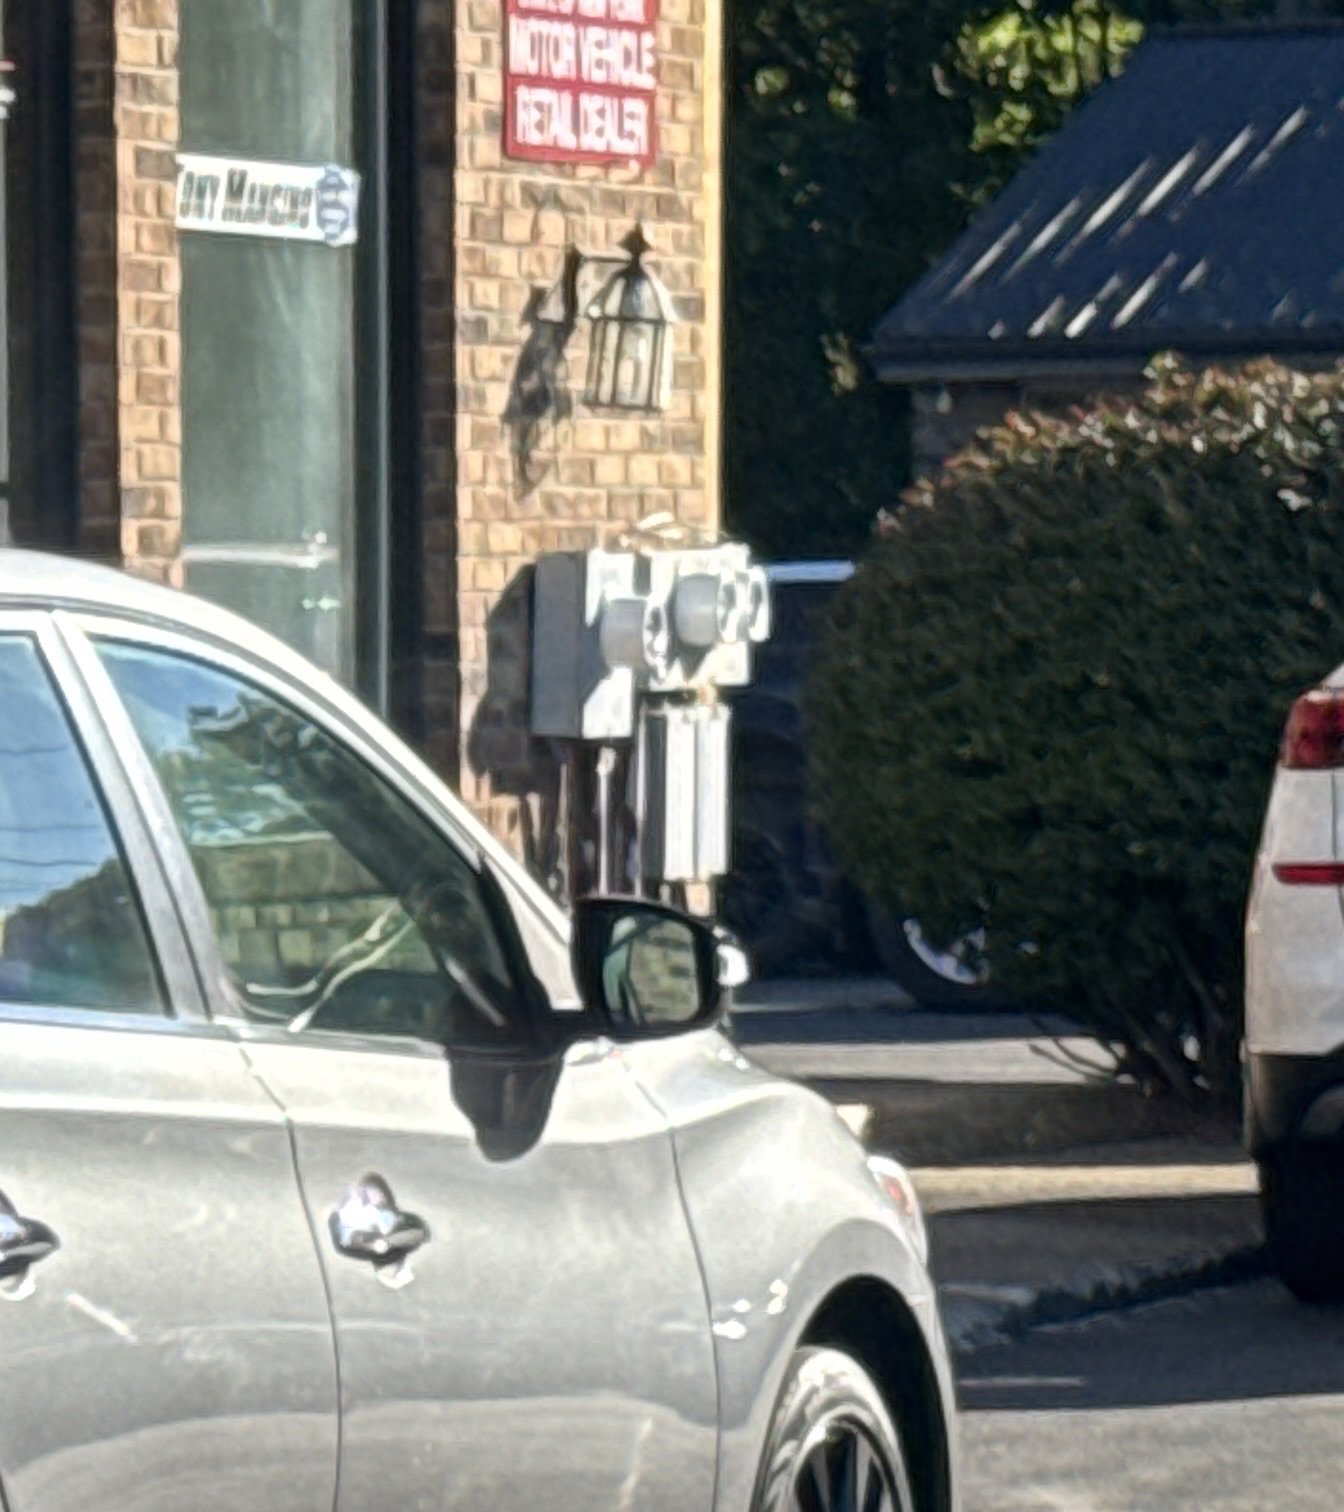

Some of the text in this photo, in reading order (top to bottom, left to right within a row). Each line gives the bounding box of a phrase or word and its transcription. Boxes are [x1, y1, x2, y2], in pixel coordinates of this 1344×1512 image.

[509, 14, 576, 78] MOTOR
[516, 85, 648, 154] RETAIL DEALER
